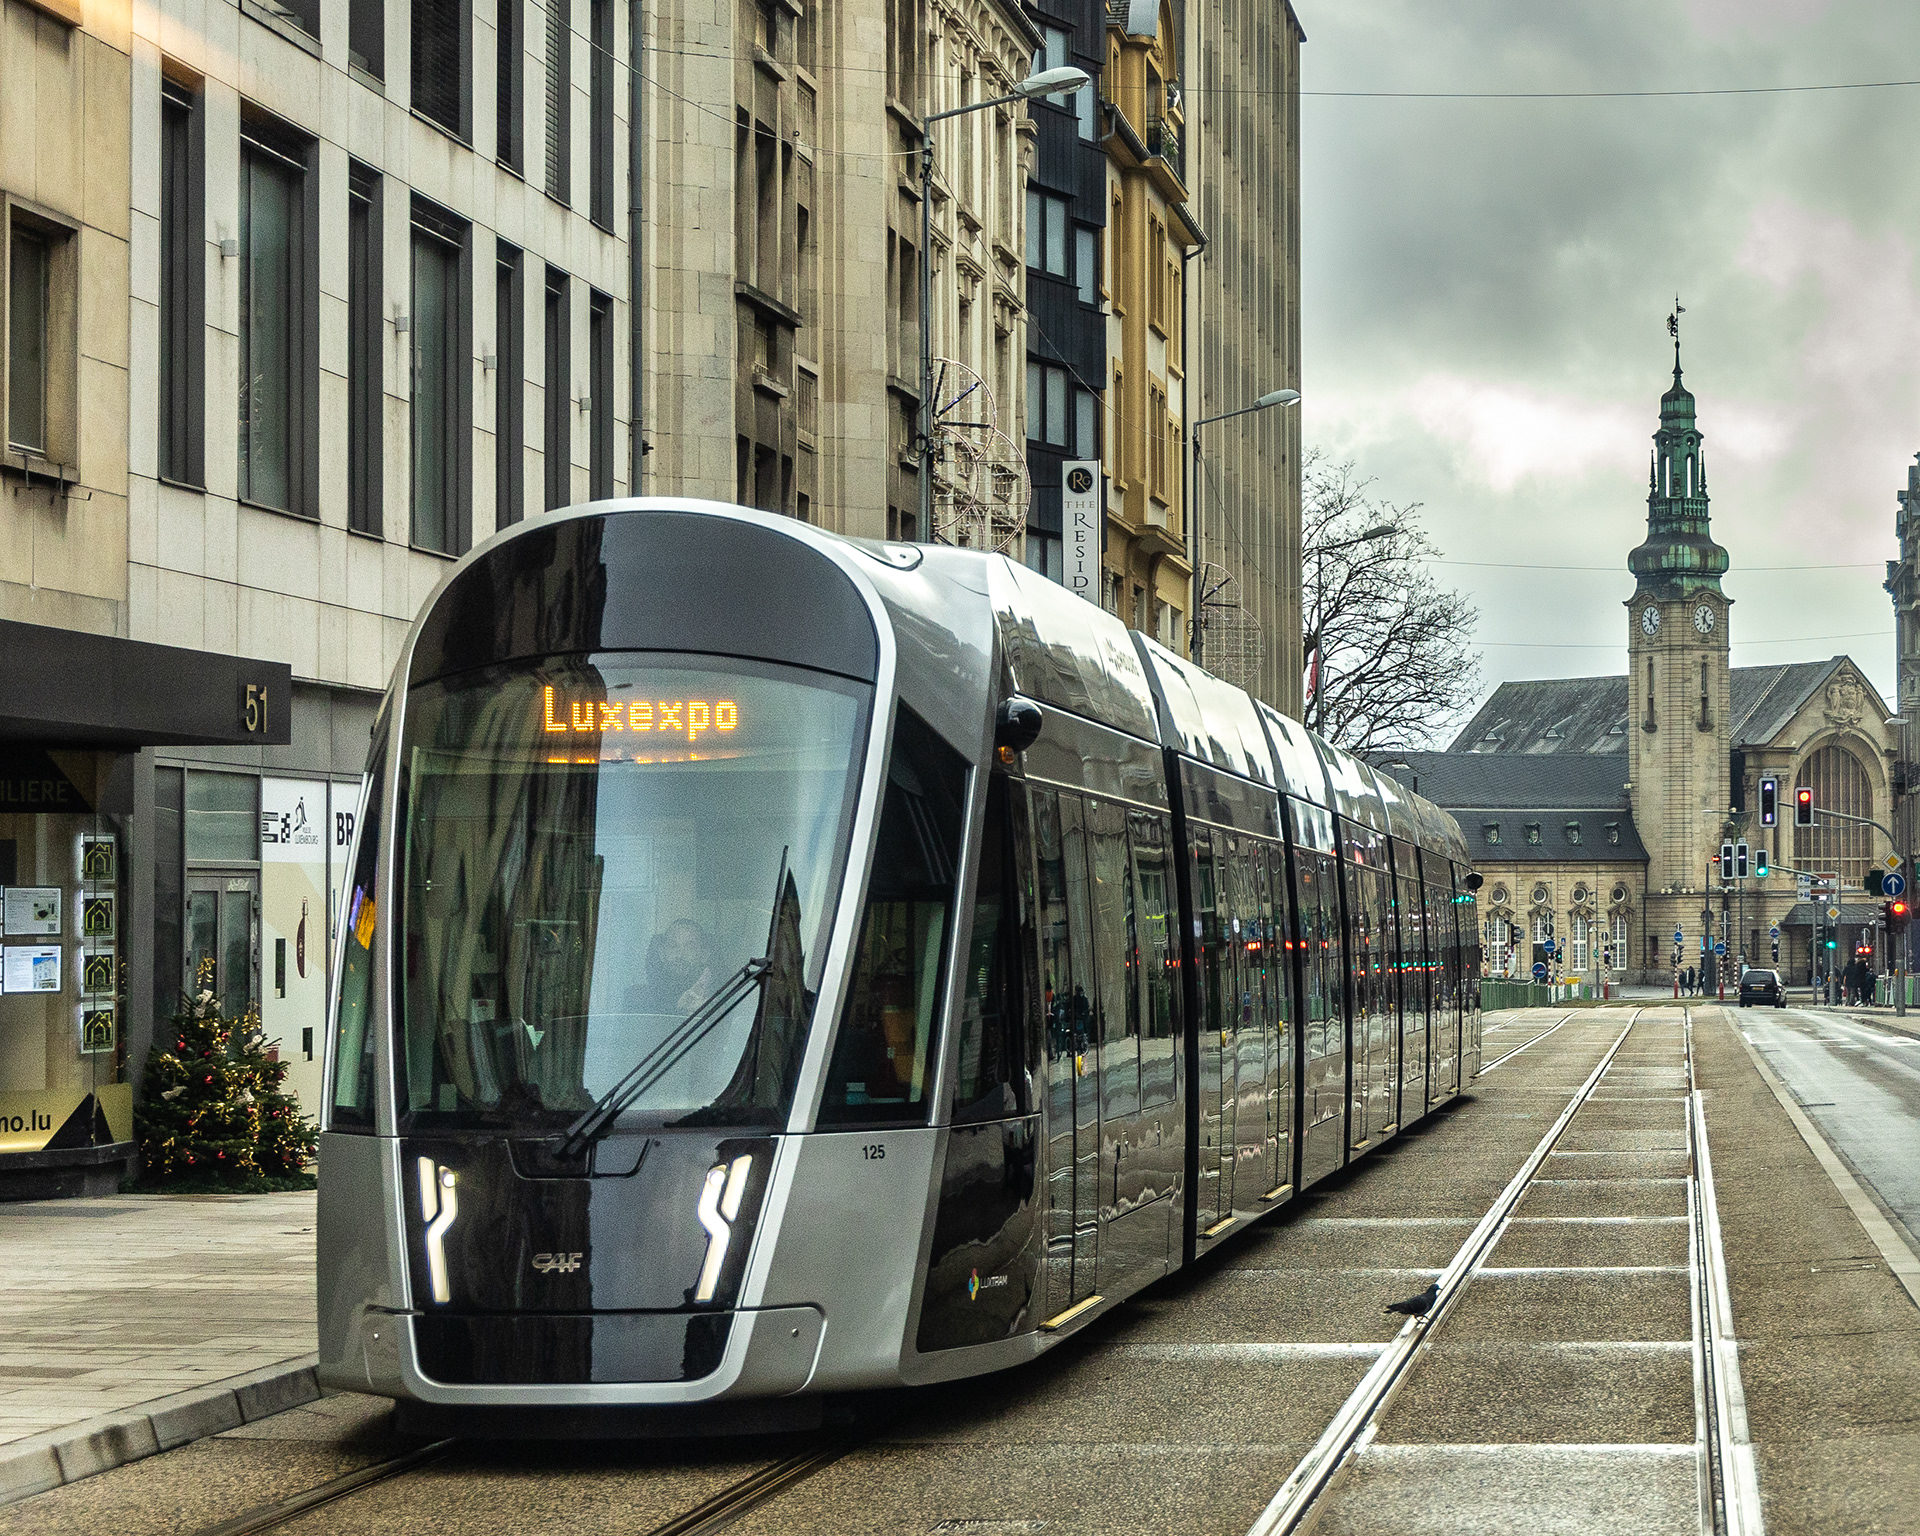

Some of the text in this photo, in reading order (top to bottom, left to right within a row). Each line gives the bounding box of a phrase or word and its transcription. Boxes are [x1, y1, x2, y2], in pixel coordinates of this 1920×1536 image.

[1064, 501, 1096, 509] THE
[245, 684, 268, 733] 51
[545, 686, 738, 741] Luxexpo
[862, 1144, 886, 1160] 125
[532, 1252, 583, 1273] CAF
[980, 1275, 1008, 1289] LUXTRAM
